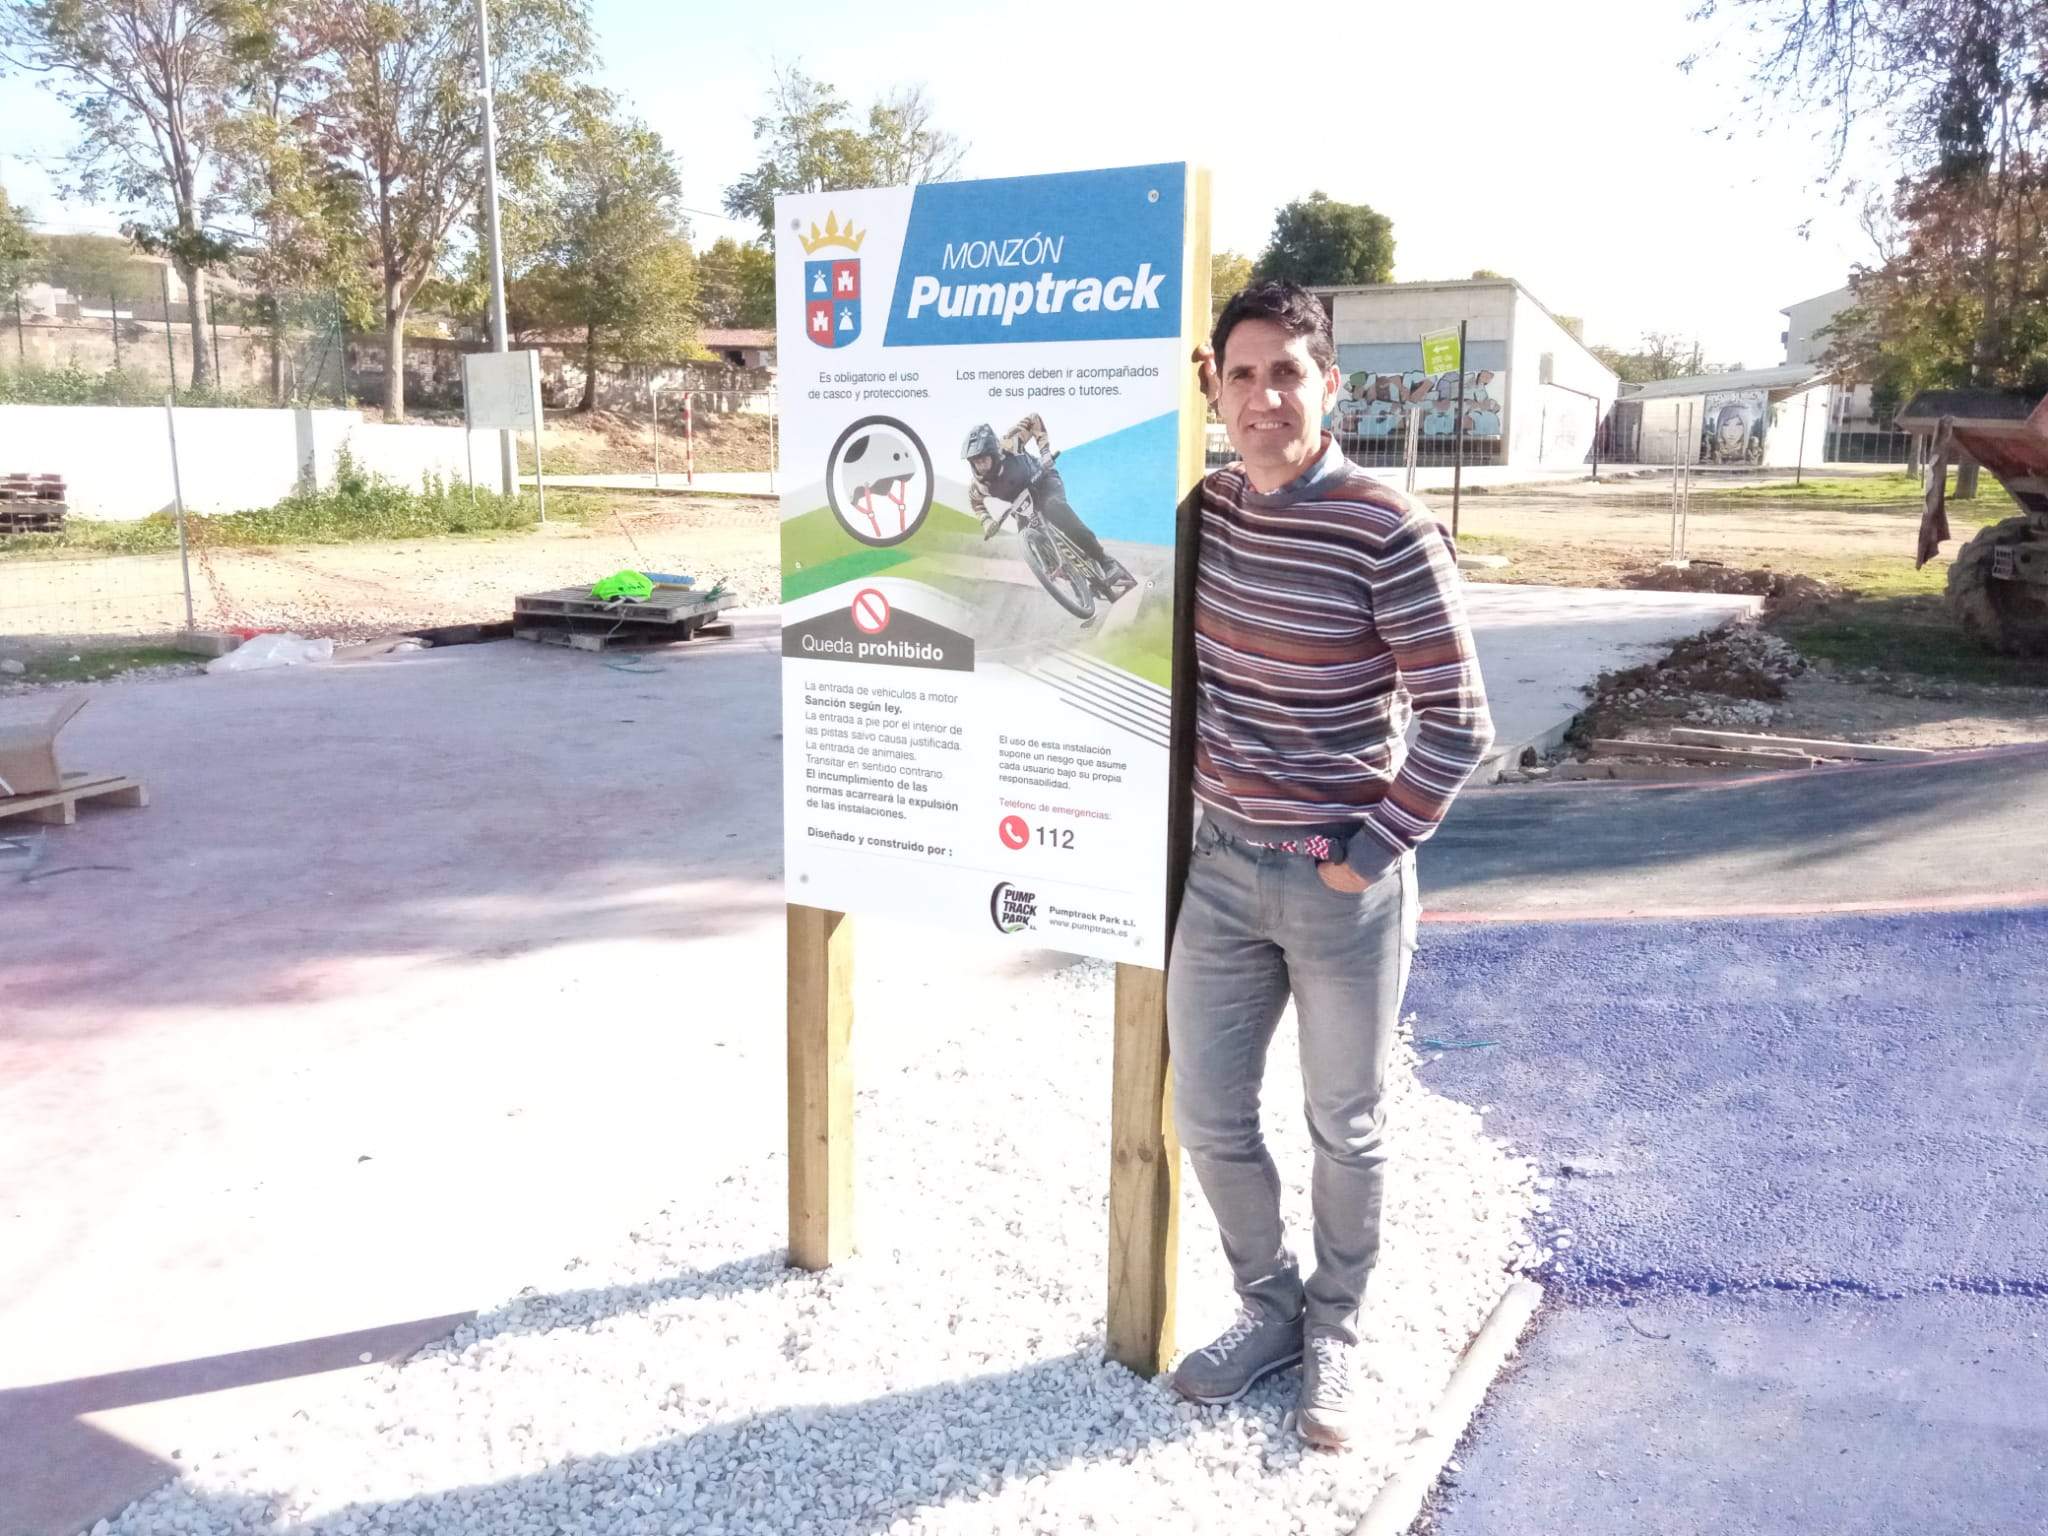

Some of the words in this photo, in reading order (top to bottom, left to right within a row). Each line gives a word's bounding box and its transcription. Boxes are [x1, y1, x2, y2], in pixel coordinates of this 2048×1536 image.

[942, 232, 1064, 270] MONZÓN
[907, 263, 1166, 326] Pumptrack
[820, 372, 831, 383] Es
[834, 372, 885, 384] obligatorio
[889, 372, 897, 381] el
[901, 372, 919, 381] uso
[957, 369, 975, 380] Los
[979, 369, 1024, 380] menores
[1028, 368, 1062, 379] deben
[1067, 367, 1074, 378] ir
[1077, 366, 1158, 380] acompañados
[808, 389, 820, 399] de
[823, 390, 852, 399] casco
[855, 390, 860, 401] y
[989, 386, 1001, 397] de
[1005, 387, 1024, 397] sus
[1028, 386, 1065, 399] padres
[1069, 386, 1075, 396] o
[1080, 385, 1121, 396] tutores.
[802, 634, 853, 654] Queda
[858, 641, 943, 660] prohibido
[805, 681, 815, 691] La
[819, 682, 853, 694] entrada
[857, 685, 868, 695] de
[920, 692, 925, 700] a
[929, 693, 958, 703] motor
[805, 695, 846, 708] Sanción
[849, 700, 881, 712] según
[885, 702, 902, 715] ley.
[805, 712, 816, 720] La
[819, 712, 854, 725] entrada
[857, 717, 862, 725] a
[866, 717, 880, 728] pie
[883, 720, 898, 730] por
[902, 720, 910, 729] el
[913, 721, 946, 733] interior
[950, 725, 962, 735] de
[806, 726, 818, 735] las
[821, 727, 848, 738] pistas
[851, 729, 875, 741] salvo
[879, 733, 907, 744] causa
[910, 735, 962, 750] justificada.
[1000, 735, 1007, 744] El
[1010, 738, 1025, 746] uso
[1028, 739, 1039, 748] de
[1042, 742, 1060, 750] esta
[1063, 744, 1111, 756] instalación
[806, 741, 816, 750] La
[819, 742, 854, 754] entrada
[857, 745, 869, 755] de
[872, 747, 916, 760] animales.
[1000, 750, 1031, 760] supone
[1034, 753, 1044, 761] un
[1047, 754, 1074, 765] riesgo
[1077, 758, 1093, 768] que
[1096, 760, 1127, 770] asume
[806, 754, 844, 768] Transitar
[848, 760, 859, 769] en
[862, 762, 896, 774] sentido
[1000, 761, 1020, 770] cada
[1023, 765, 1054, 774] usuario
[1057, 768, 1076, 778] bajo
[1079, 771, 1090, 779] su
[1093, 772, 1122, 783] propia
[806, 769, 815, 778] El
[818, 770, 894, 788] incumplimiento
[897, 780, 909, 790] de
[913, 780, 928, 792] las
[1000, 774, 1071, 790] responsabilidad.
[806, 785, 843, 797] normas
[897, 794, 905, 804] la
[909, 797, 958, 811] expulsión
[1039, 802, 1049, 812] de
[806, 799, 818, 808] de
[822, 799, 835, 810] las
[838, 800, 906, 819] instalaciones.
[808, 827, 855, 842] Diseñado
[859, 836, 864, 845] y
[868, 837, 924, 852] construido
[928, 845, 945, 856] por
[1036, 826, 1074, 849] 112
[1004, 889, 1035, 903] PUMP
[1003, 901, 1037, 916] TRACK
[1050, 905, 1096, 921] Pumptrack
[1100, 913, 1120, 925] Park
[1123, 919, 1136, 927] s.l.
[1002, 912, 1030, 926] PARK
